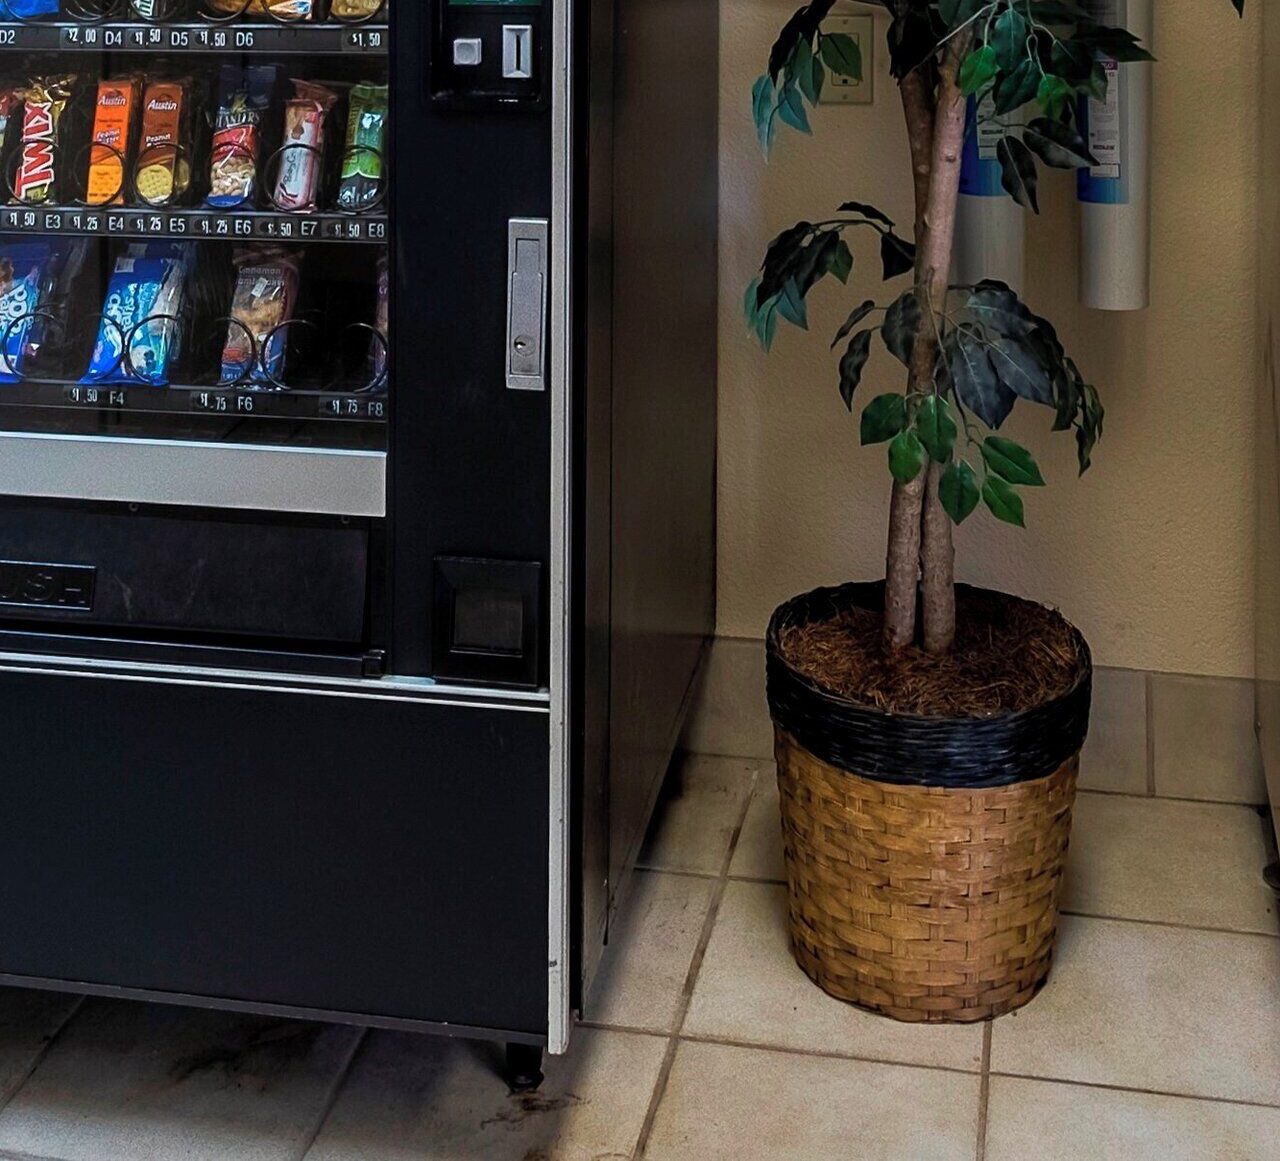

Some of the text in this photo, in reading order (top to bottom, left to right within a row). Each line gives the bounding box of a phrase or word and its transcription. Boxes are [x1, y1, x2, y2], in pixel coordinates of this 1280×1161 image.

[105, 31, 122, 45] D4
[171, 31, 188, 46] D5
[236, 31, 253, 46] D6
[98, 95, 126, 107] Austin
[147, 99, 178, 111] Austin
[15, 102, 55, 200] TWIX
[46, 215, 61, 228] E3
[109, 217, 124, 230] E4
[170, 218, 185, 232] E5
[235, 220, 251, 235] E6
[302, 221, 317, 235] E7
[369, 223, 385, 237] E8
[110, 390, 125, 404] F4
[237, 397, 252, 411] F6
[368, 402, 383, 416] F8
